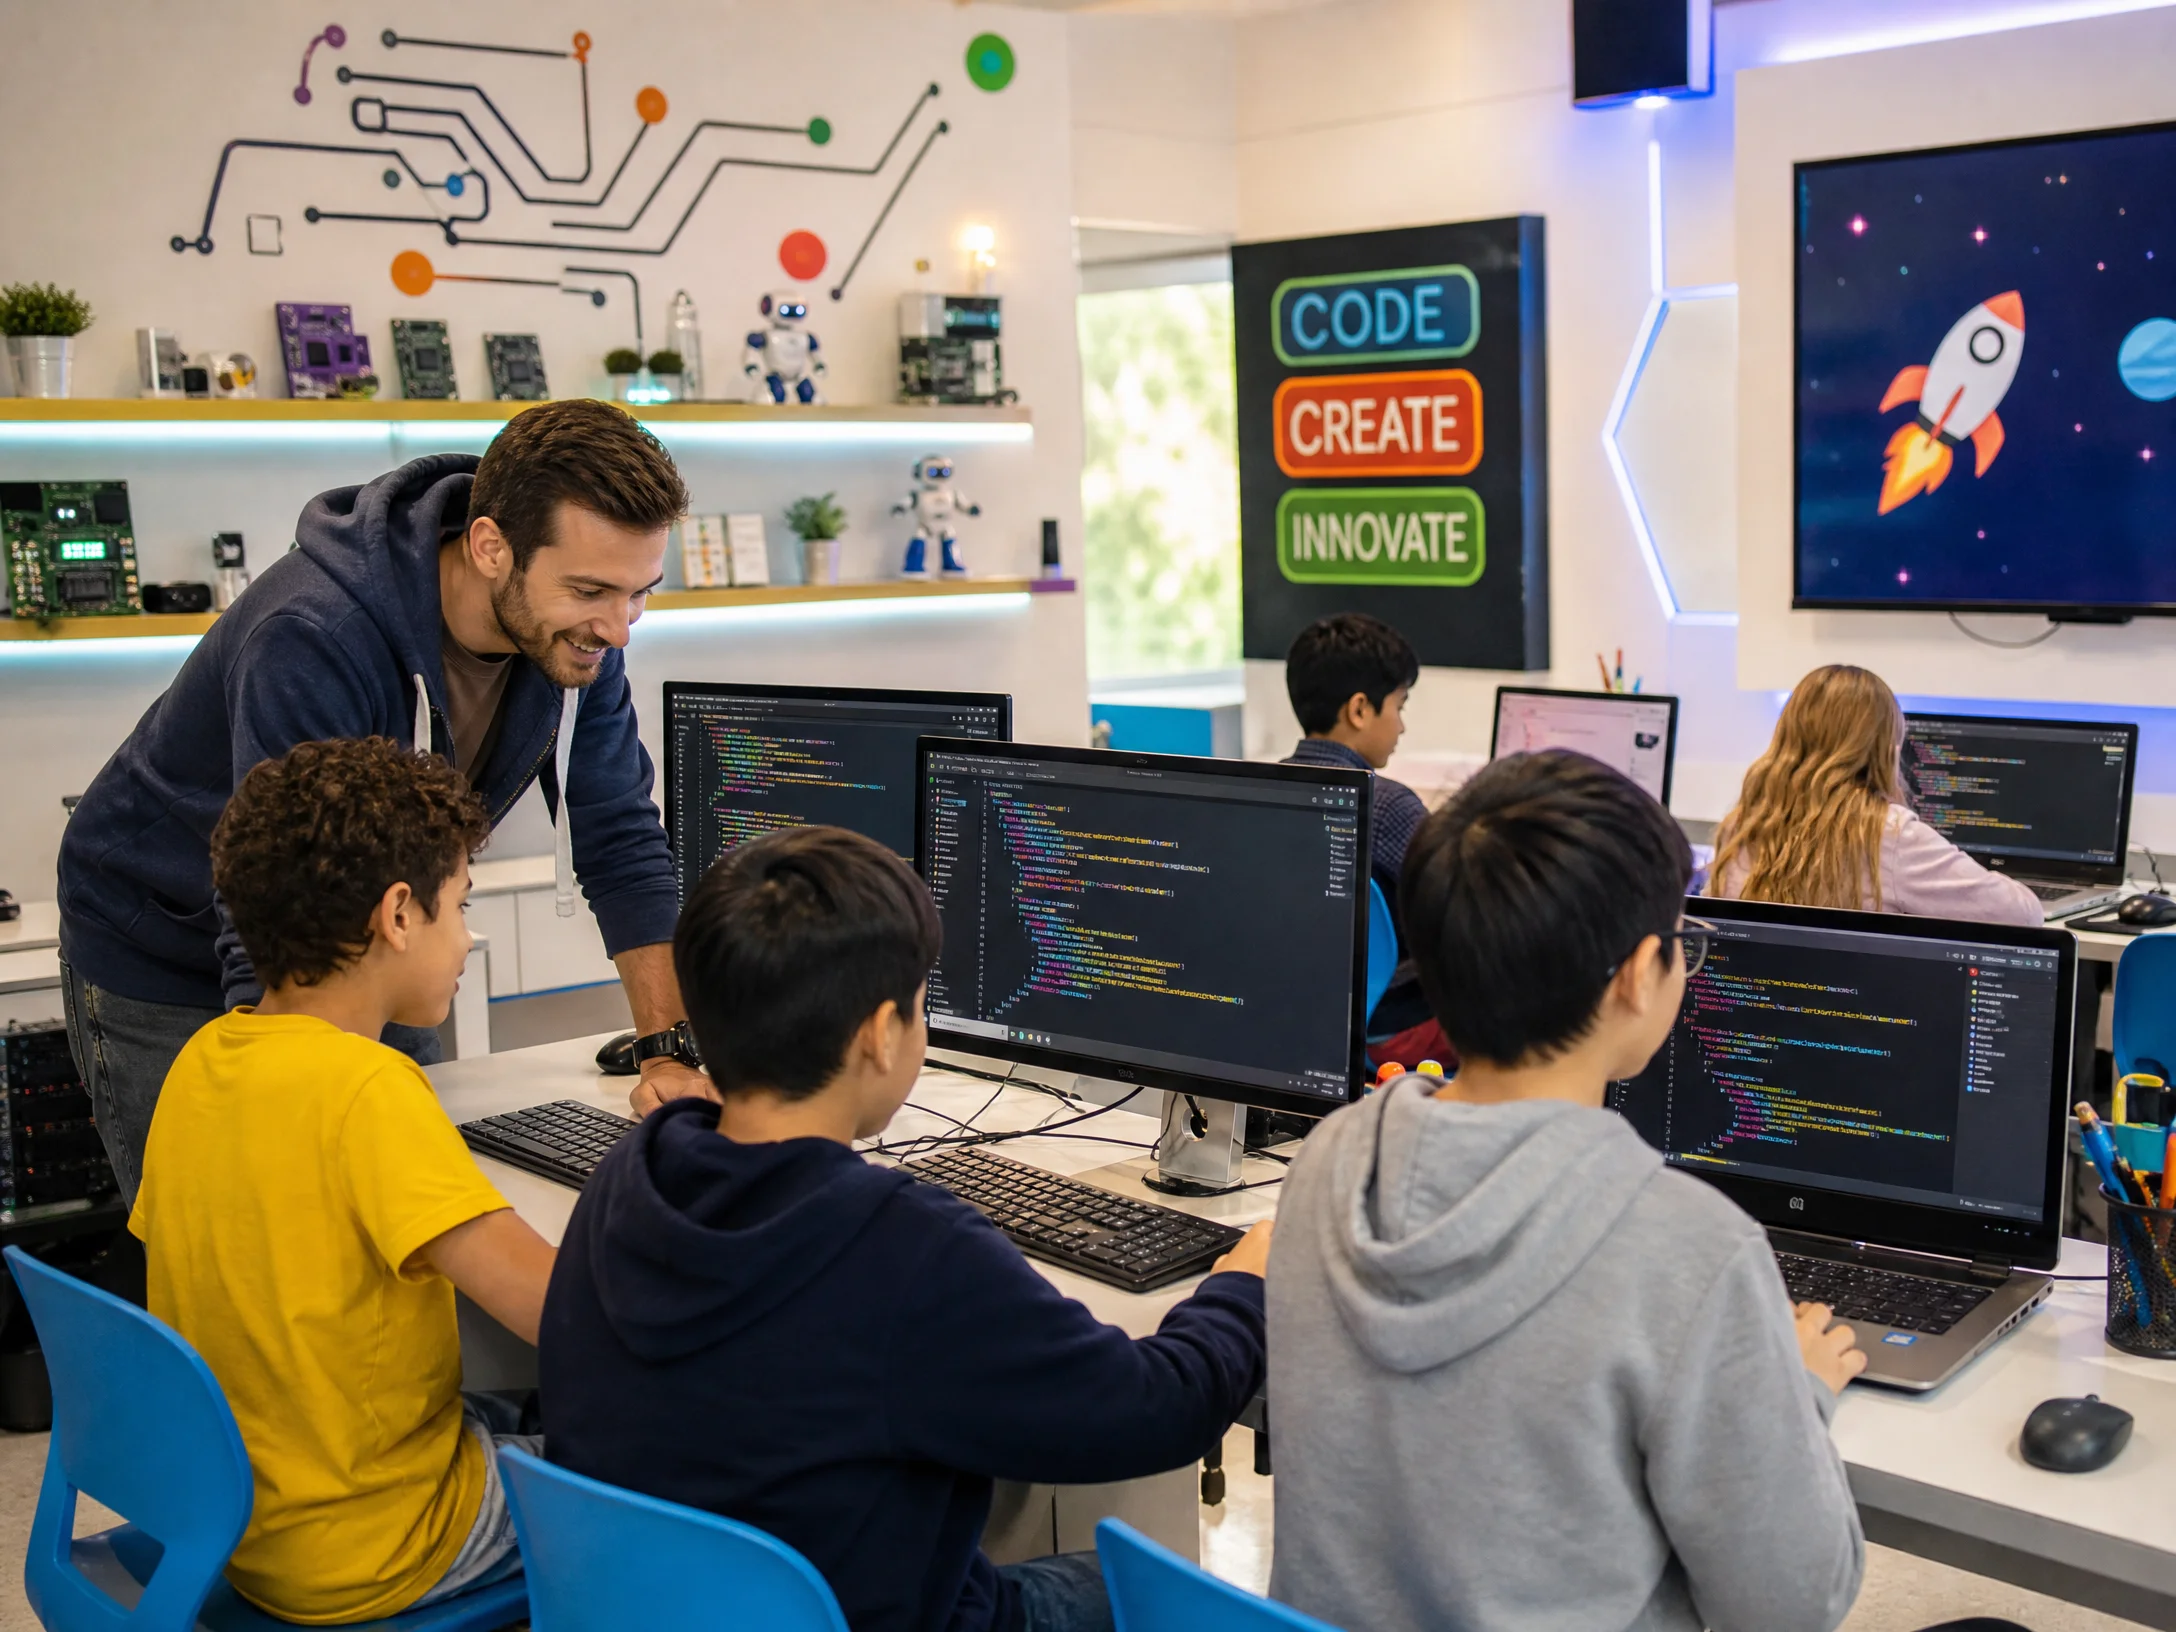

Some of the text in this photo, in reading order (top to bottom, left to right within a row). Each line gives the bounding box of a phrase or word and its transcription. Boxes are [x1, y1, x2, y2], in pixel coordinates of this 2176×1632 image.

[1291, 285, 1444, 350] CODE
[1290, 395, 1459, 456] CREATE
[1292, 512, 1468, 562] INNOVATE
